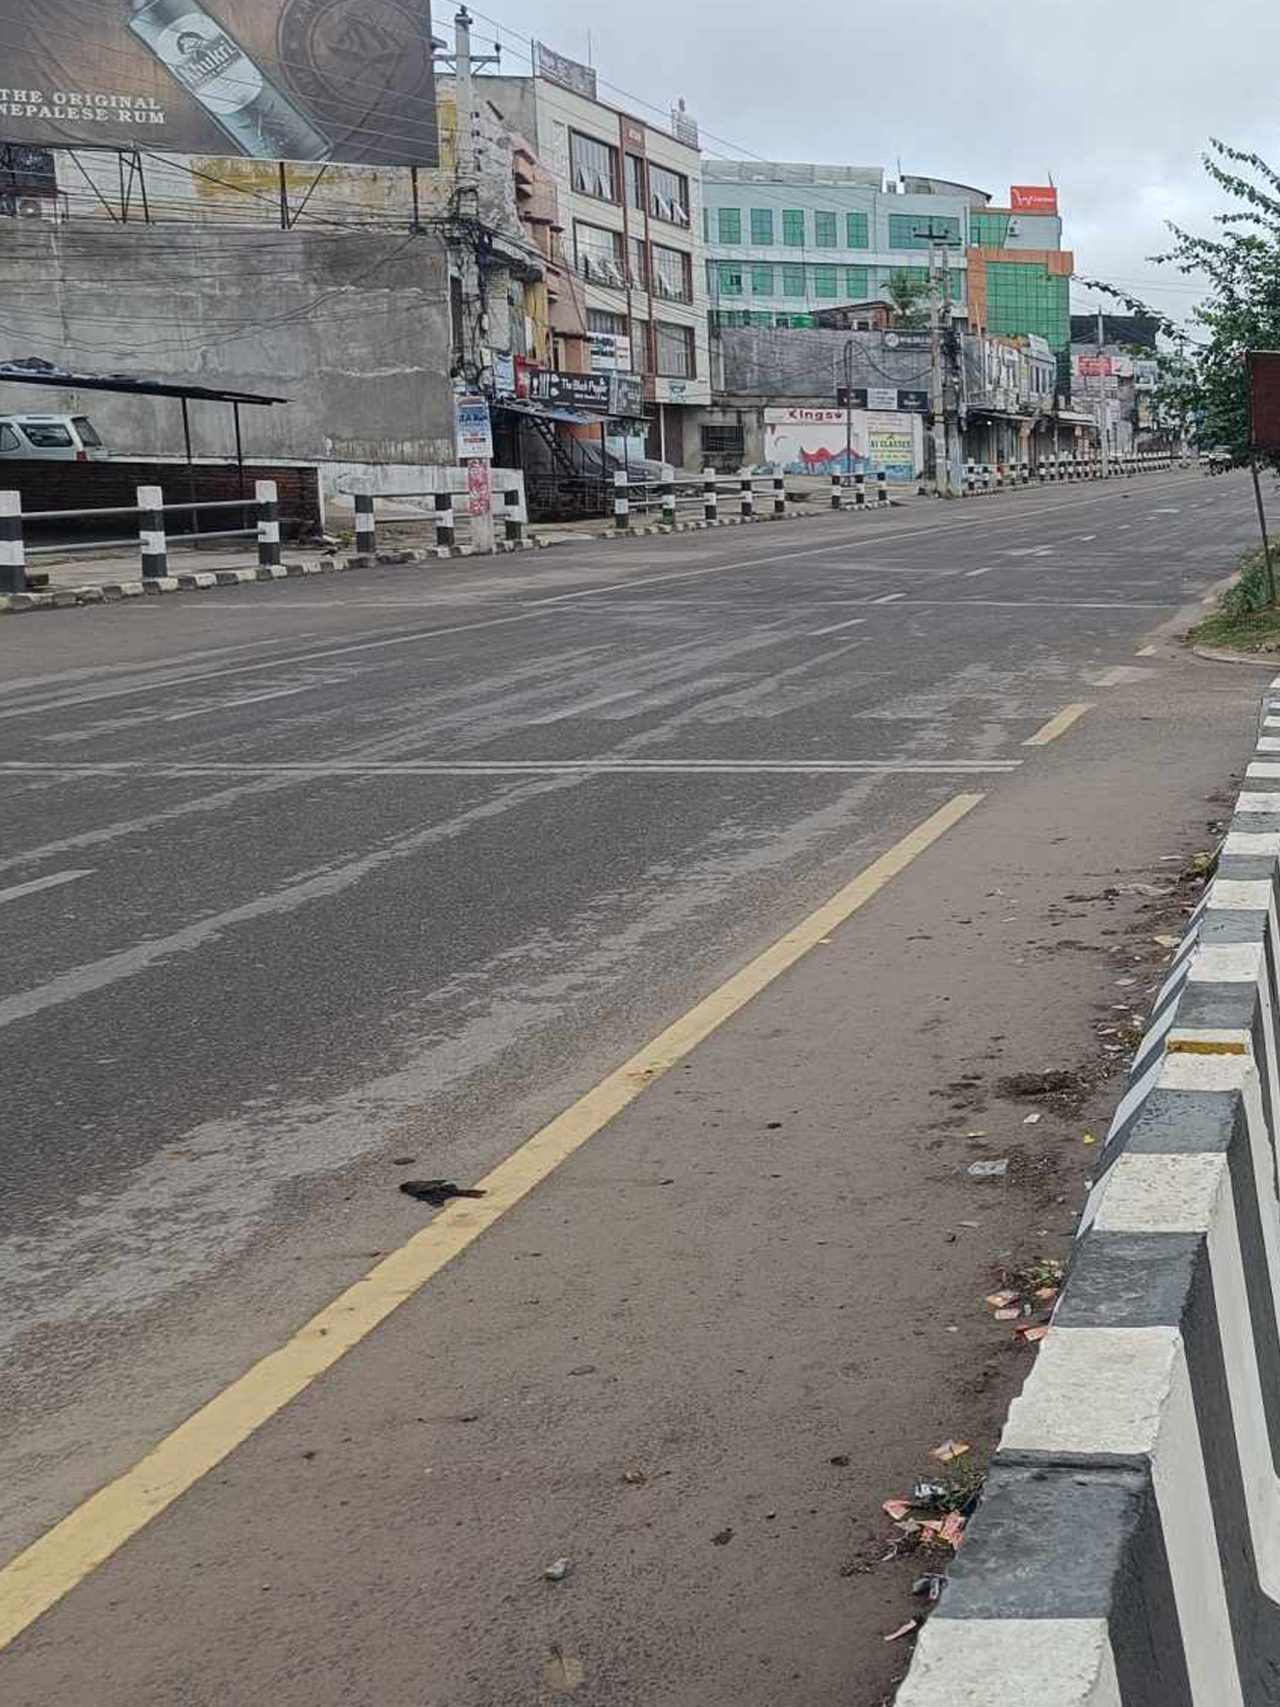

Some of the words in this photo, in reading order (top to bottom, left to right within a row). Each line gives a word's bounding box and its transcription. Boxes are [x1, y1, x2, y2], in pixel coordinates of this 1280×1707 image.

[0, 89, 43, 102] THE
[53, 92, 161, 110] ORIGINAL
[119, 109, 165, 124] RUM
